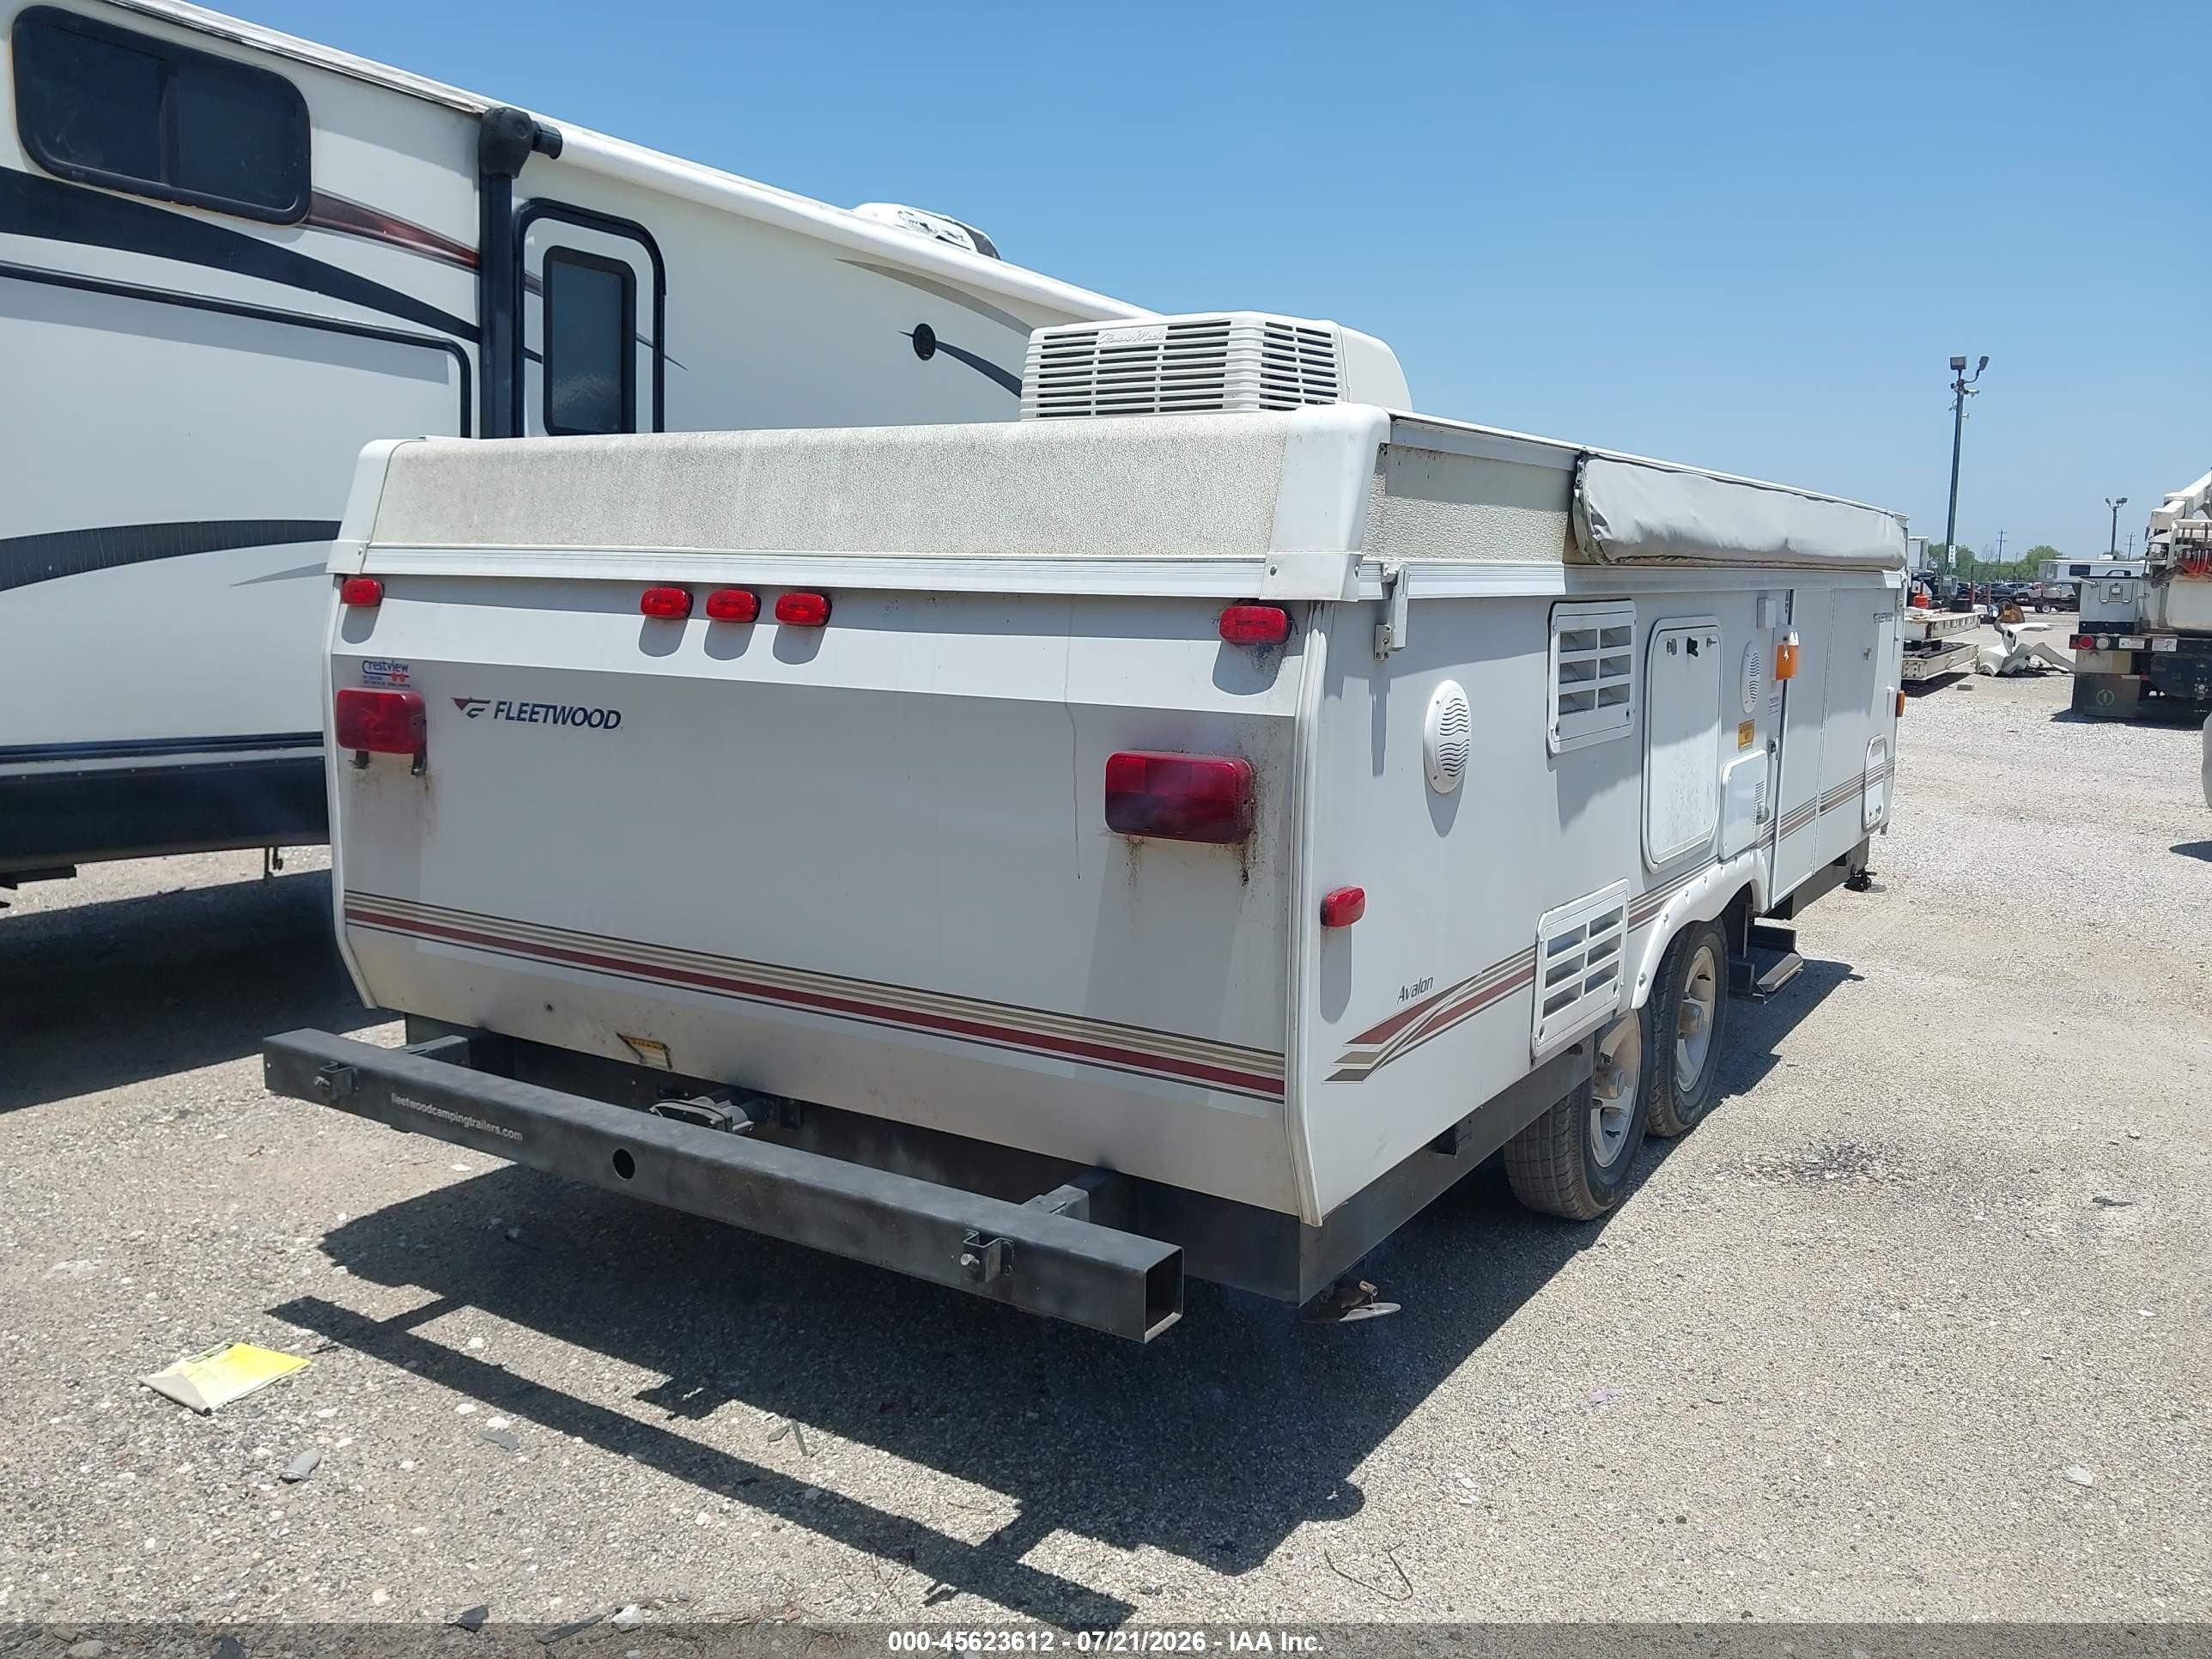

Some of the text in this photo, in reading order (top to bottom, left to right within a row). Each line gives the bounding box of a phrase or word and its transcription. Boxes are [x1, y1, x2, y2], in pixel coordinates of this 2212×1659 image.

[362, 659, 410, 677] Crestview
[494, 700, 622, 730] FLEETWOOD
[1396, 976, 1434, 1005] Avalon
[391, 1092, 523, 1142] fleetwoodcampingtrailers.com
